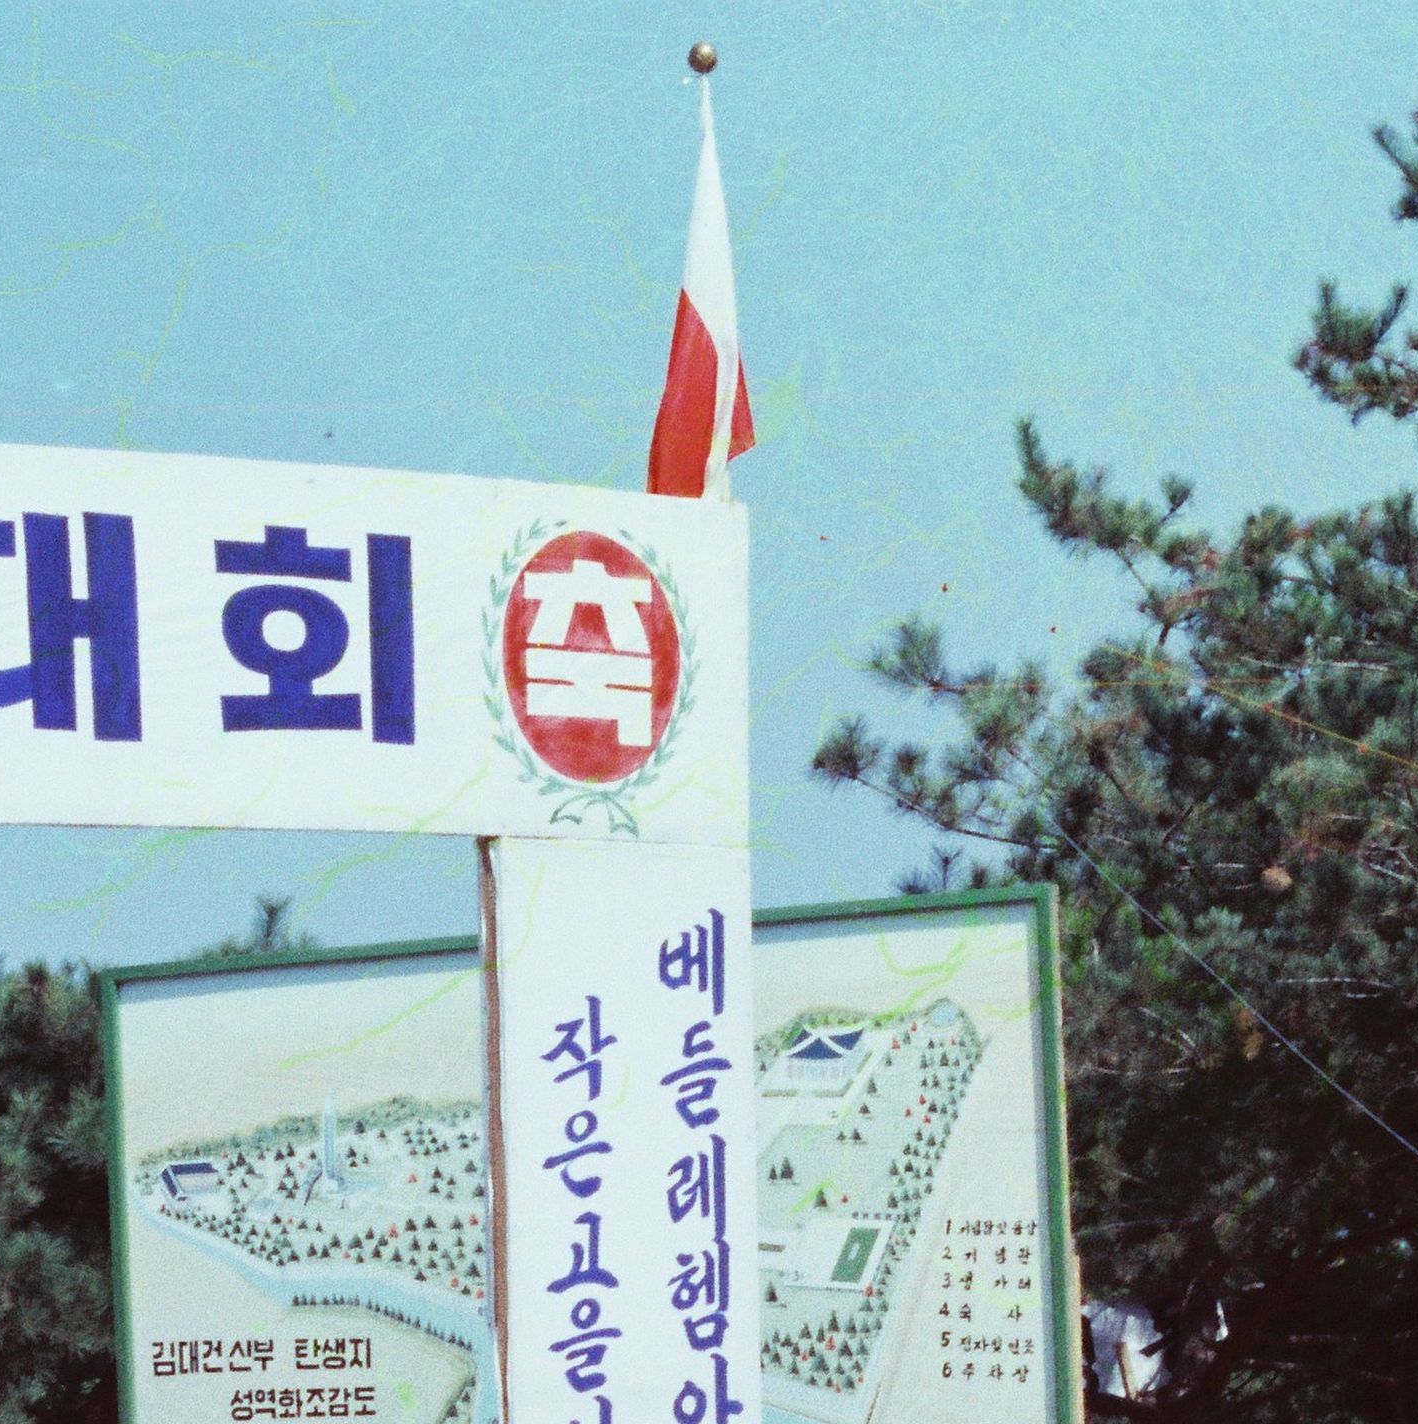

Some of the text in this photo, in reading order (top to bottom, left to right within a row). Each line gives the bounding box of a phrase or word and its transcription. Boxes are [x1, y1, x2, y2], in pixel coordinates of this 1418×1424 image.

[523, 558, 652, 747] 축
[942, 1246, 953, 1260] 2
[941, 1272, 951, 1289] 3
[939, 1302, 950, 1316] 4
[941, 1331, 952, 1347] 5
[152, 1337, 373, 1377] 김대건신부 탄생지
[942, 1362, 953, 1378] 6
